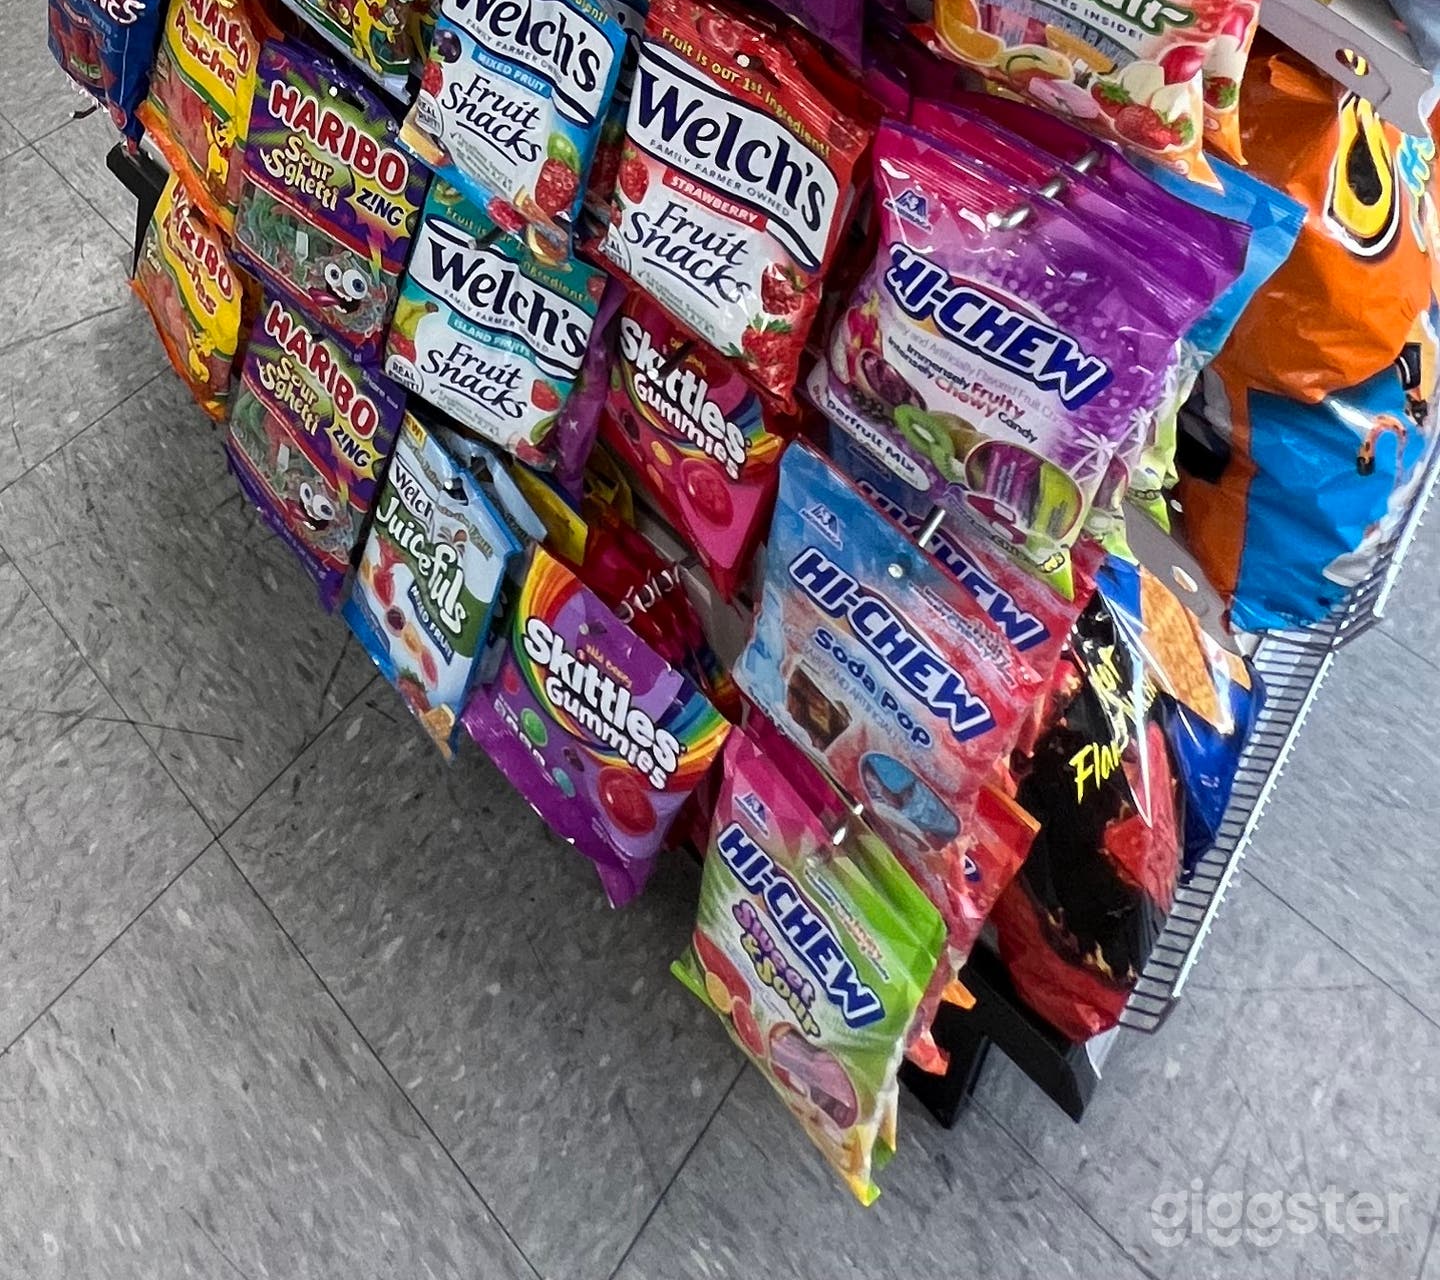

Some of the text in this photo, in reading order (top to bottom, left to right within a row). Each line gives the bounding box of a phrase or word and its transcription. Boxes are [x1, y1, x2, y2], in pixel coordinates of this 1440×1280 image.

[662, 28, 693, 57] Fruit
[696, 50, 709, 65] is
[711, 59, 741, 84] our
[1083, 7, 1145, 43] INSIDE!
[471, 74, 541, 130] Fruit
[513, 67, 547, 94] FRUIT
[268, 80, 409, 196] HARIBO
[284, 134, 335, 182] Sour
[442, 81, 542, 165] Snacks
[637, 69, 826, 234] Welch's
[649, 138, 791, 218] FAMILY FARMER OWNED
[669, 174, 759, 223] STRAWBERRY
[624, 209, 753, 304] Snacks
[655, 200, 749, 267] Fruit
[428, 236, 588, 359] Welch's
[885, 243, 1115, 410] HI-CHEW
[264, 300, 380, 440] HARIBO
[279, 356, 319, 415] Sour
[392, 361, 416, 382] REAL
[420, 349, 528, 420] Snacks
[446, 340, 525, 391] Fruit
[619, 316, 751, 466] Skttles
[971, 381, 1026, 419] Fruity
[634, 373, 742, 482] Gummies
[998, 411, 1038, 444] Candy
[394, 463, 436, 524] Welch
[375, 497, 467, 636] Juicefuls
[789, 546, 997, 741] HI-CHEW
[523, 615, 687, 775] Skittles
[814, 627, 931, 749] Soda Pop
[545, 675, 668, 791] Gummies
[716, 822, 887, 1029] HI-CHEW
